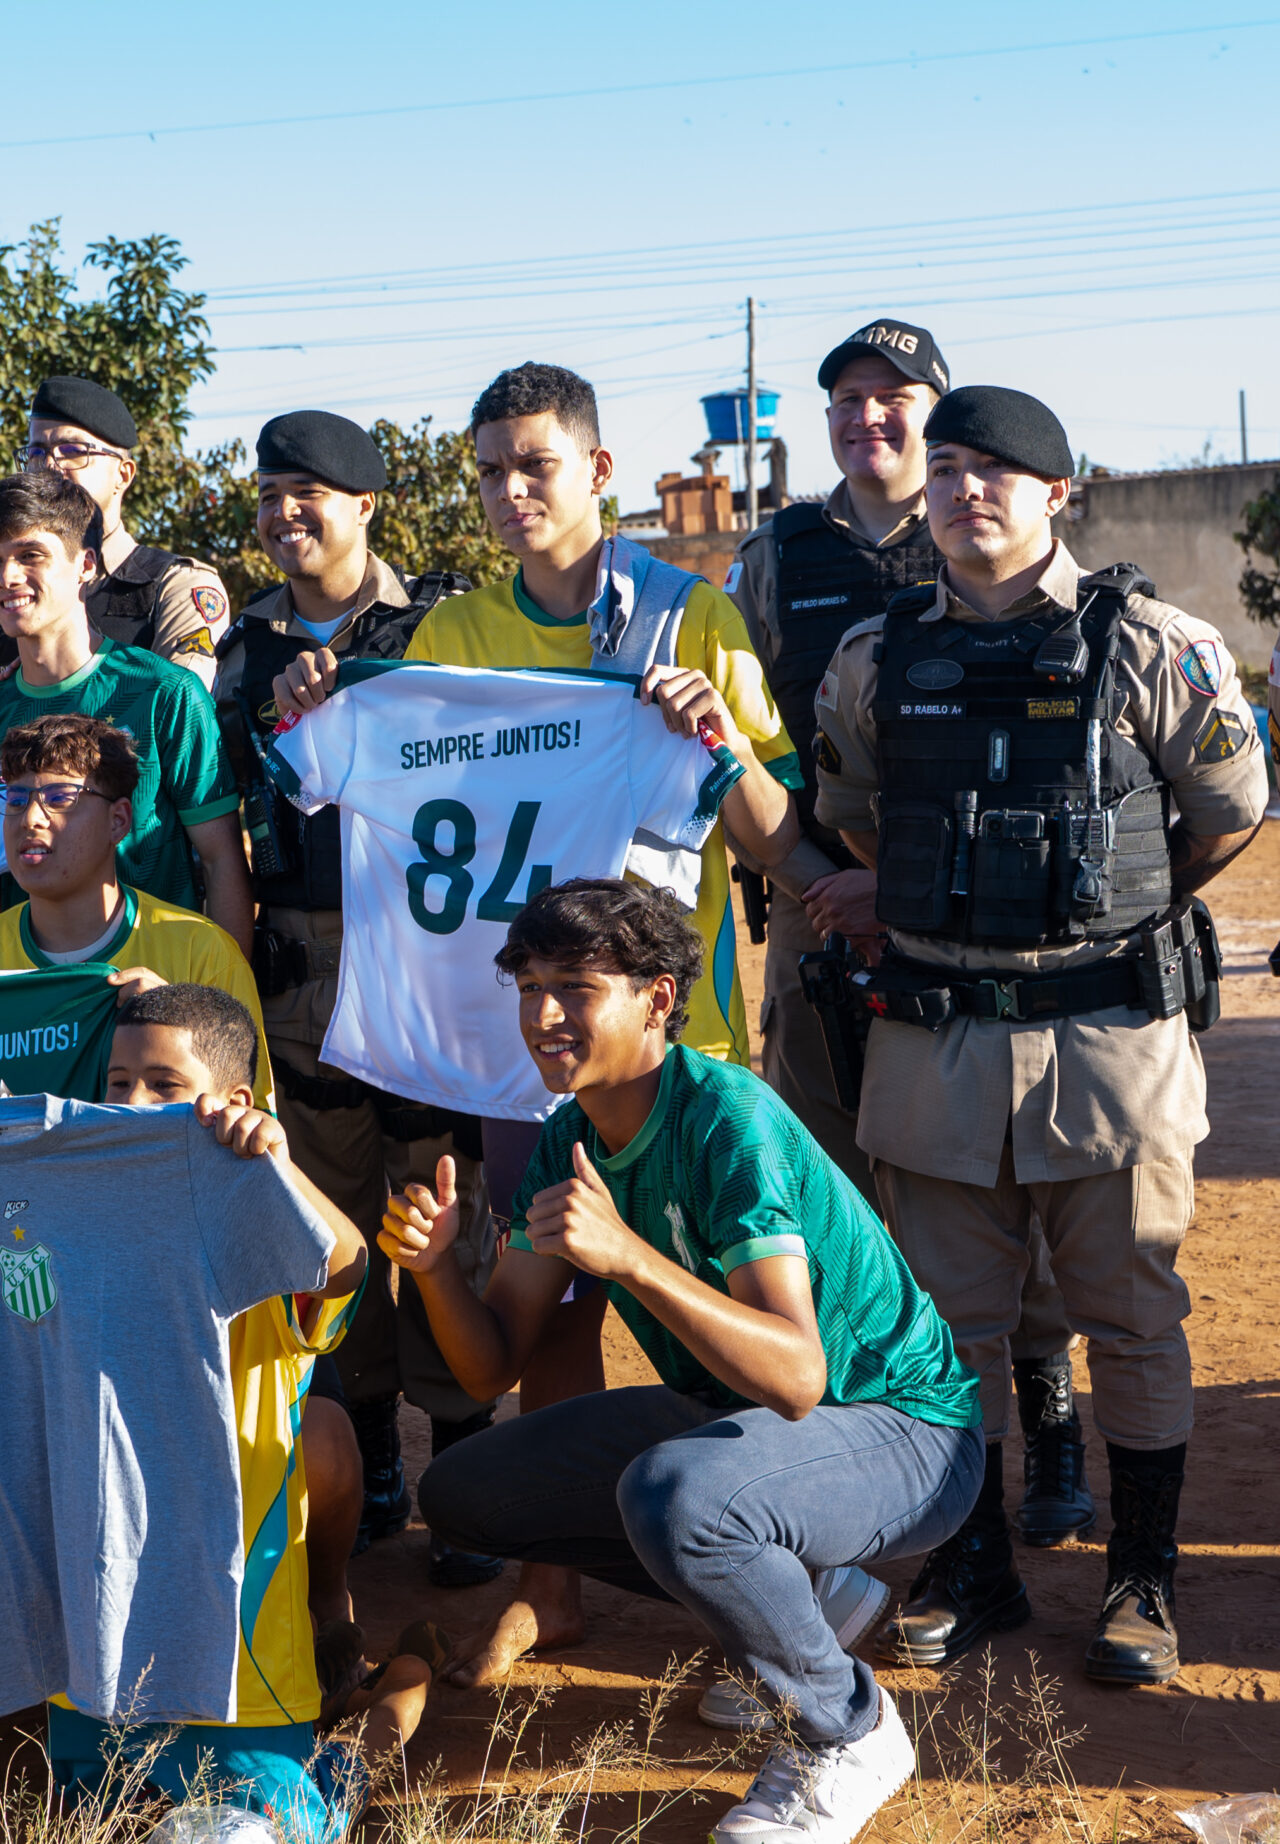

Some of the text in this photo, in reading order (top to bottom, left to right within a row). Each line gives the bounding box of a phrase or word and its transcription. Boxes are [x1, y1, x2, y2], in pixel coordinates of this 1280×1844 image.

[839, 326, 919, 355] MMG
[900, 704, 963, 714] SD RABELO A+
[1027, 707, 1075, 716] MILITAR
[400, 719, 581, 770] SEMPRE JUNTOS!
[405, 798, 553, 935] 84
[6, 1201, 27, 1211] KICK
